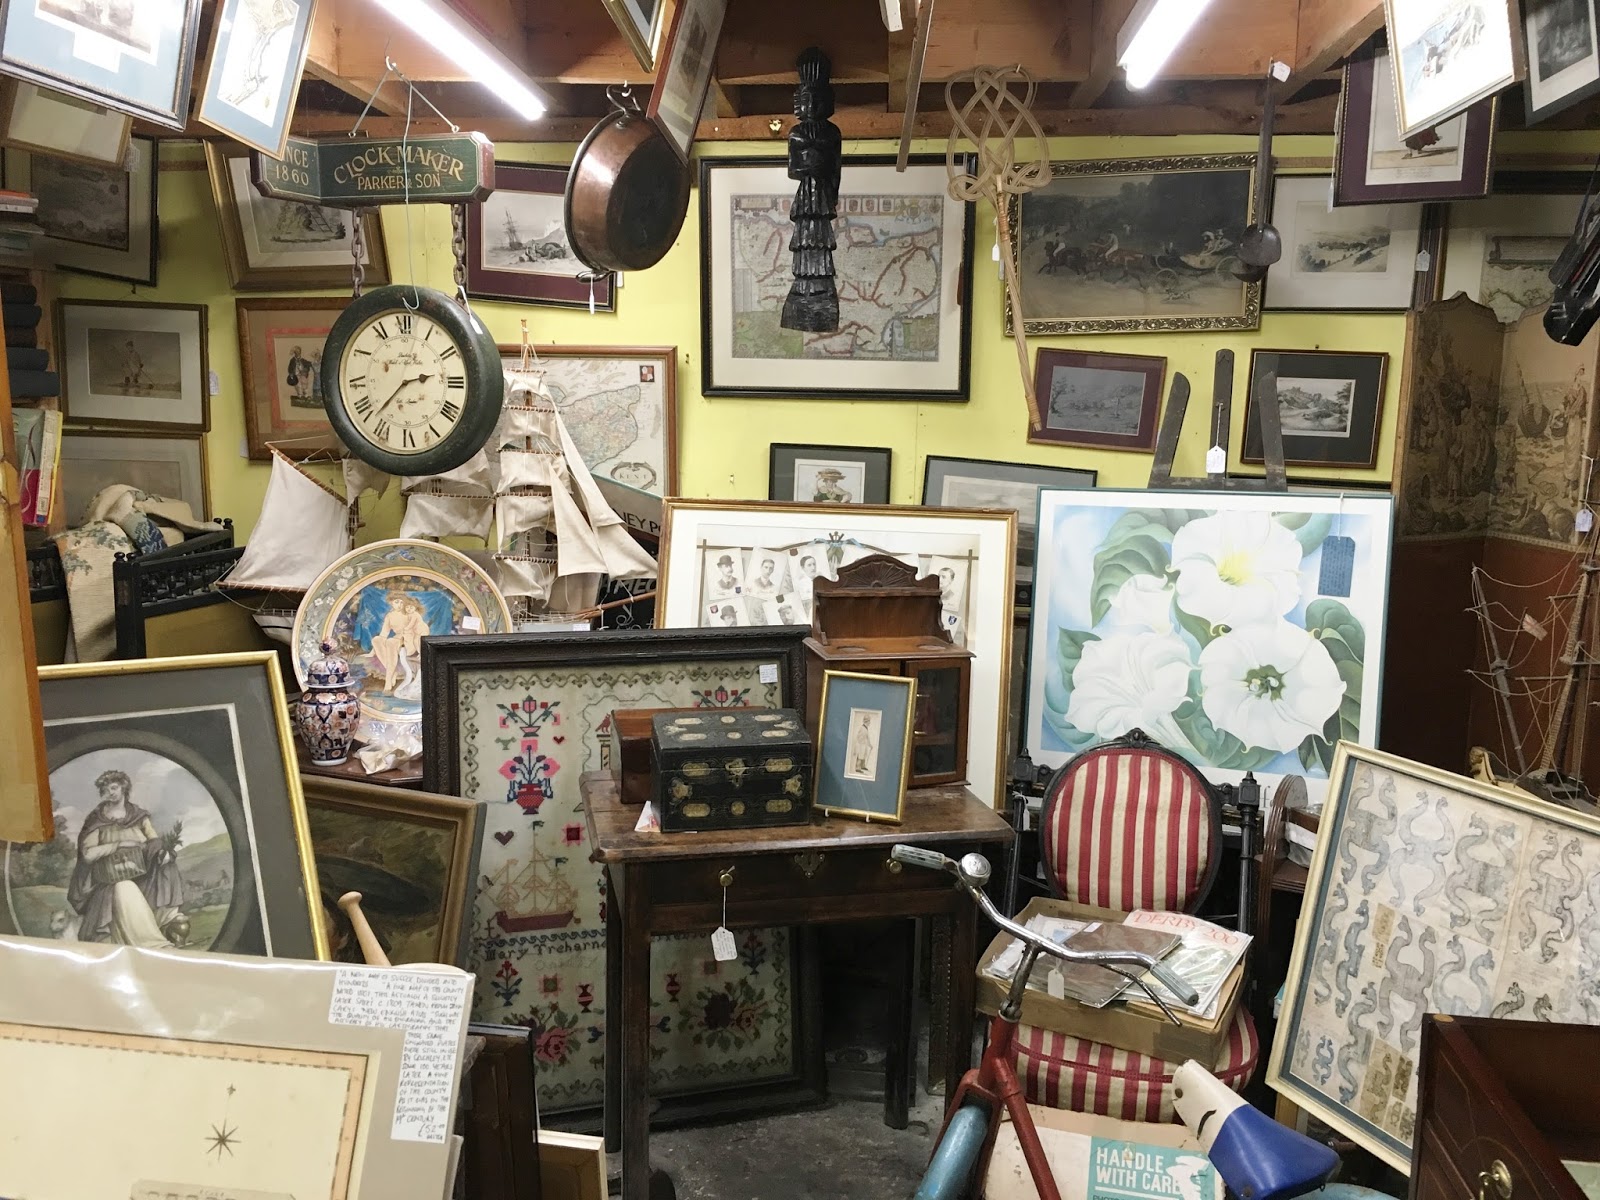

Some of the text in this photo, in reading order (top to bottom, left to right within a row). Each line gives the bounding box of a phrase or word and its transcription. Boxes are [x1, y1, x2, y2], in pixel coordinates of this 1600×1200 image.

[286, 146, 309, 168] NCE
[276, 164, 309, 186] 1860
[358, 175, 405, 190] PARKER
[415, 173, 441, 188] SON
[1135, 913, 1238, 945] DERBY 200
[485, 948, 529, 960] Mary
[1096, 1146, 1164, 1174] HANDLE
[1096, 1165, 1181, 1195] WITH CARE
